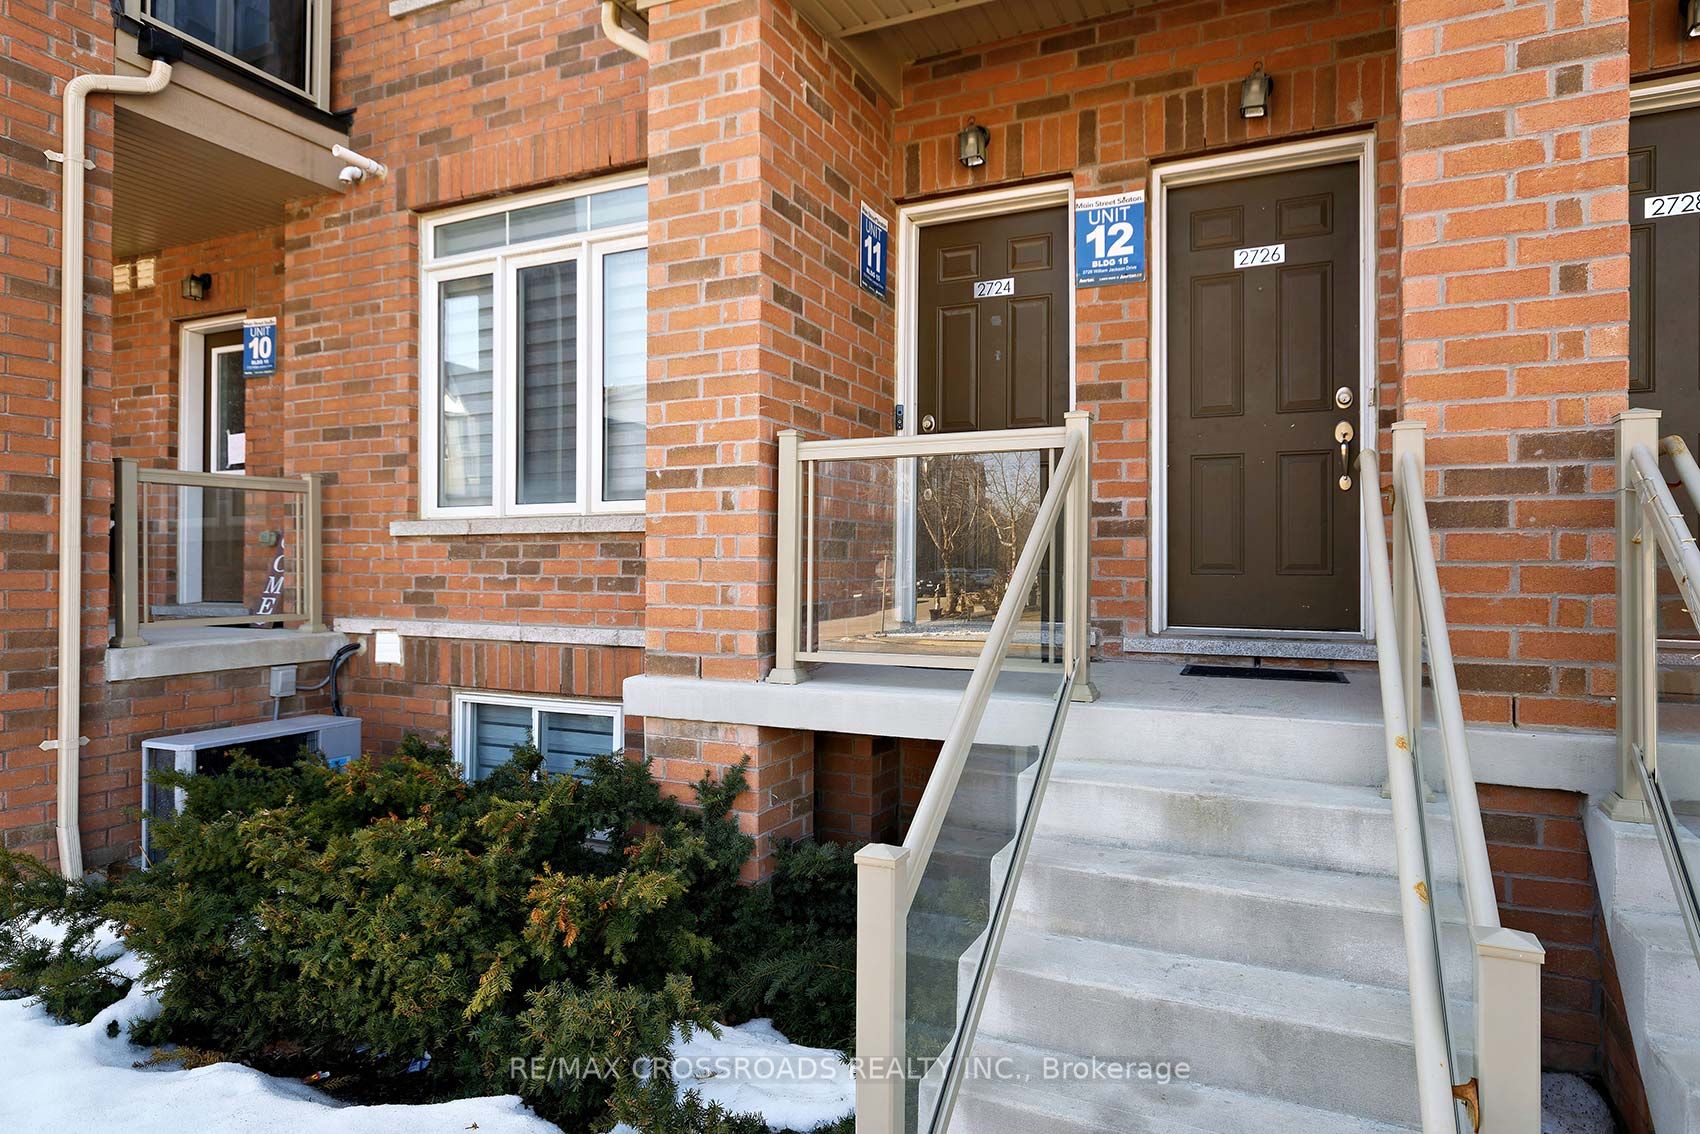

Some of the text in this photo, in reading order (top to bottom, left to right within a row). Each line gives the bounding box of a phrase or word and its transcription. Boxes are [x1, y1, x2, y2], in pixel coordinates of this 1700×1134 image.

[1095, 199, 1116, 207] Street
[1088, 206, 1131, 225] UNIT
[865, 218, 882, 241] UNIT
[1086, 222, 1134, 259] 12
[864, 235, 881, 273] 11
[1092, 257, 1129, 268] BLDG 15
[1239, 246, 1281, 266] 2726
[977, 280, 1011, 297] 2724
[250, 326, 271, 337] UNIT
[248, 336, 272, 359] 10
